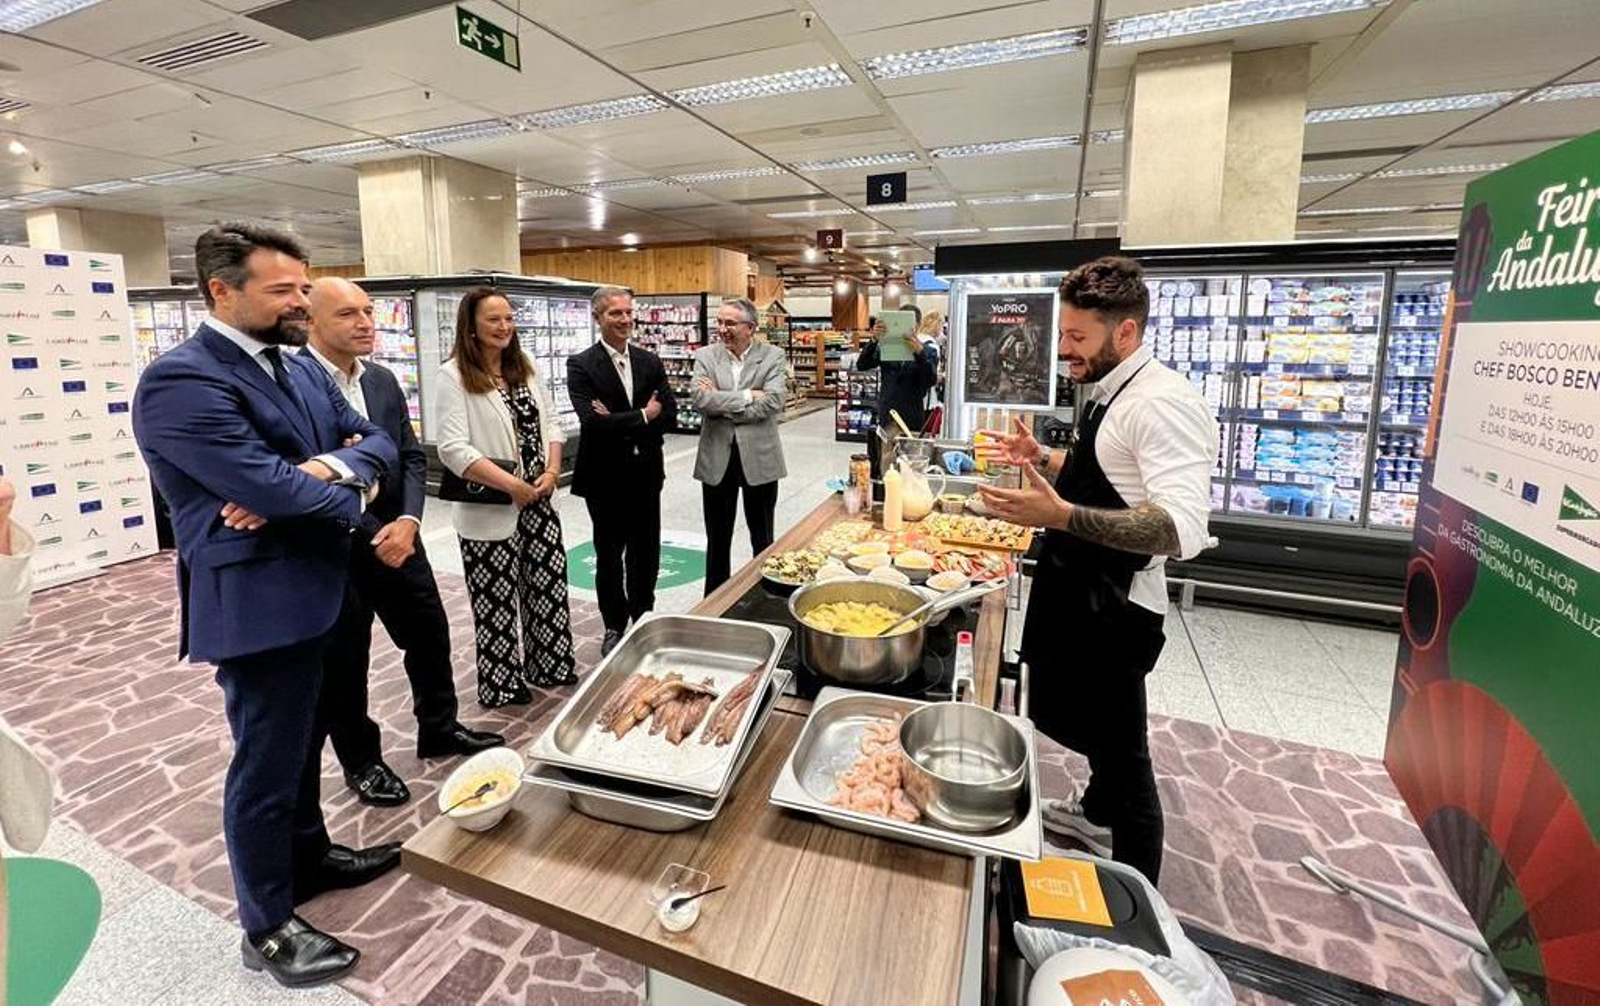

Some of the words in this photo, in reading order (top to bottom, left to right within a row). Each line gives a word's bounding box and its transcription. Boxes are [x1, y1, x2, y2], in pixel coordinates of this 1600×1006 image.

[881, 182, 892, 197] 8
[1537, 177, 1600, 232] Feir
[825, 234, 834, 245] 9
[1516, 230, 1533, 252] da
[1487, 227, 1600, 307] Andalu
[991, 303, 1028, 314] YoPRO
[1473, 360, 1504, 378] CHEF
[1507, 363, 1558, 386] BOSCO
[1488, 404, 1507, 420] DAS
[1487, 423, 1506, 439] DAS
[1556, 440, 1599, 463] 20H00
[1438, 523, 1449, 539] DA
[1449, 530, 1515, 583] GASTRONOMIA
[1516, 572, 1534, 595] DA
[1462, 519, 1510, 560] DESCUBRA
[1512, 549, 1523, 564] O
[1524, 555, 1577, 597] MELHOR
